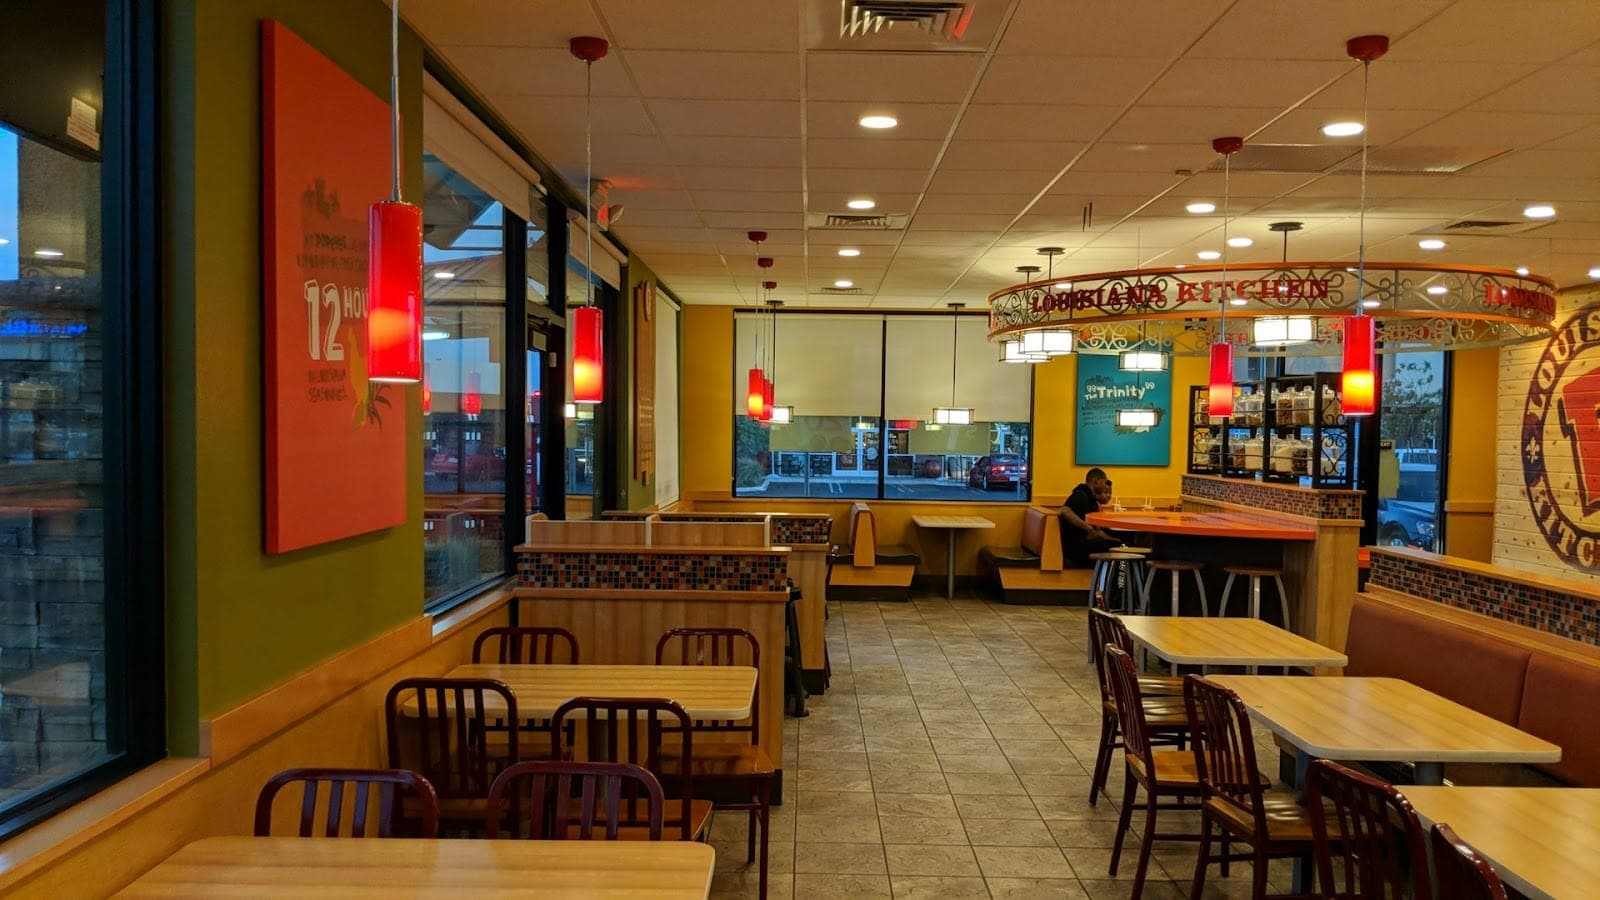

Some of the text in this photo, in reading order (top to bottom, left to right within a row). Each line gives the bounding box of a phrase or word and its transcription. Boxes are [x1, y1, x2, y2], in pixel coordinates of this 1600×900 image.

[304, 280, 344, 361] 12
[1031, 279, 1331, 313] LOUISIANA KITCHEN
